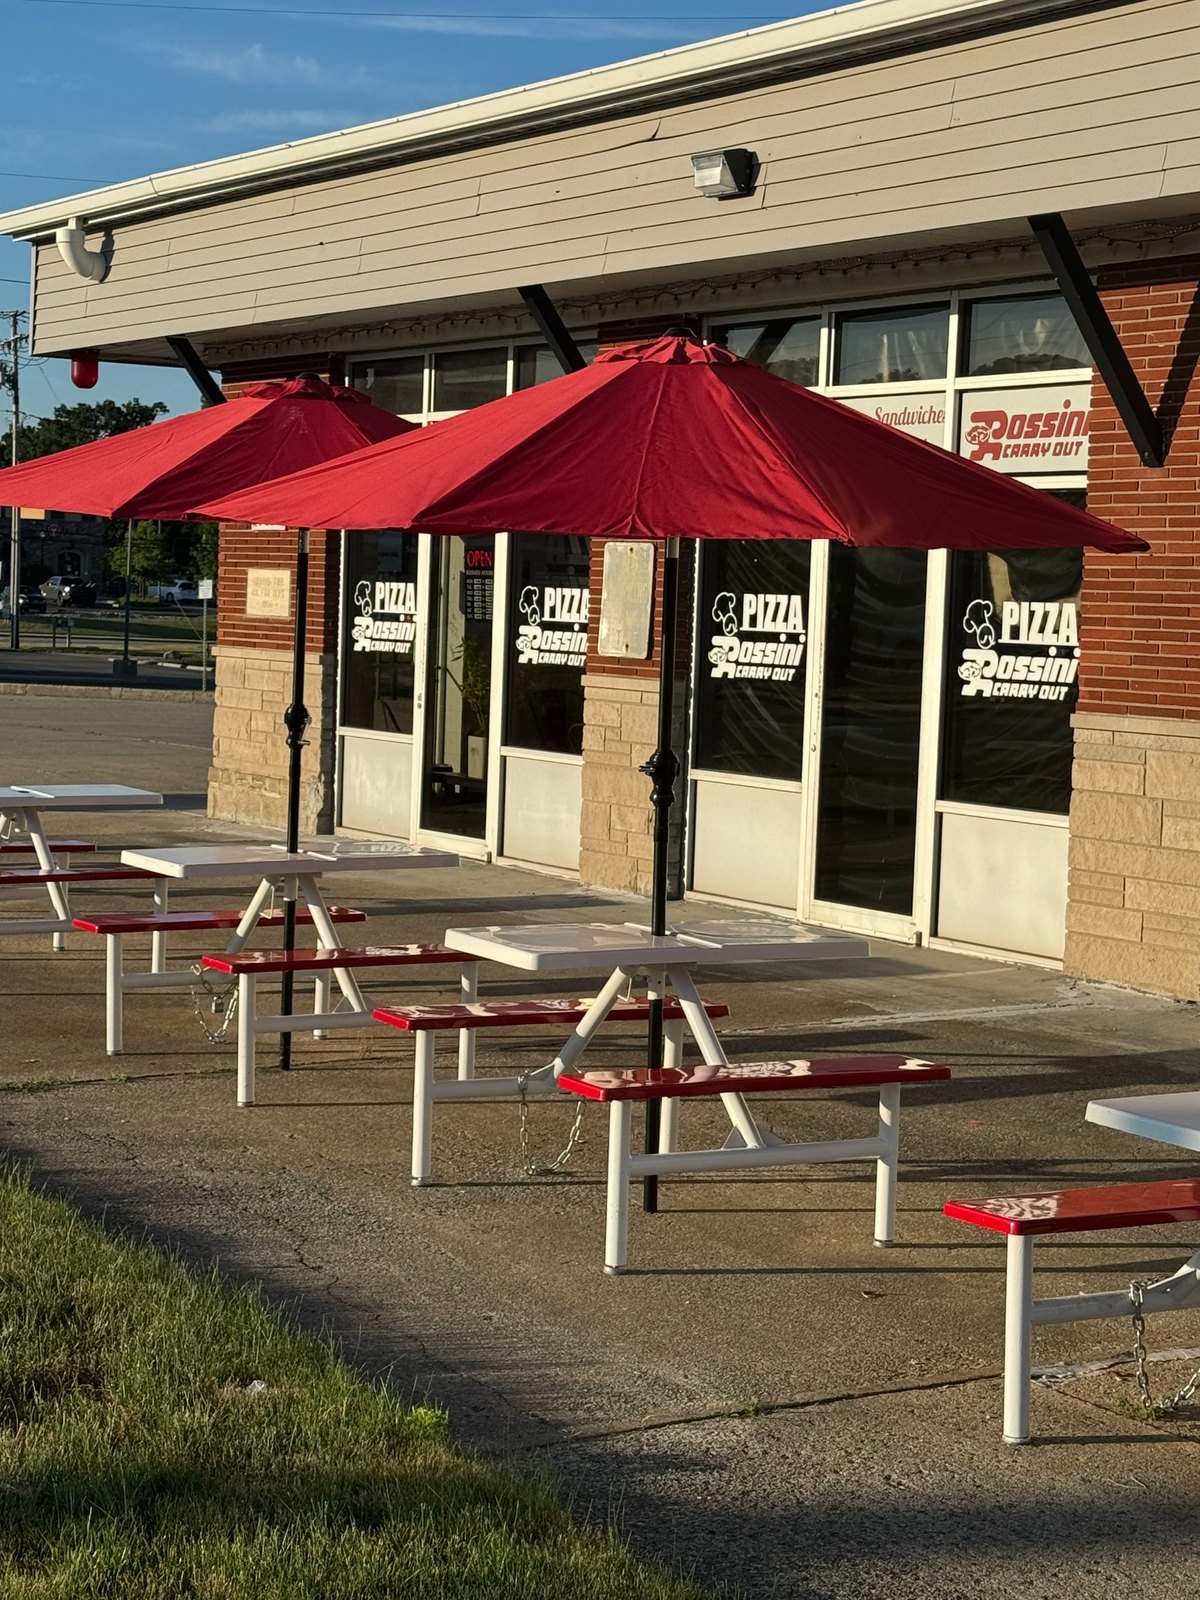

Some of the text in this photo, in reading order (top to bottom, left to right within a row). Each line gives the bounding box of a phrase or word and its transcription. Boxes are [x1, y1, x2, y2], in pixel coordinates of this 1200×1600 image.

[1002, 441, 1083, 458] CARRY OUT
[467, 550, 492, 567] OPEN
[374, 582, 417, 613] PIZZA
[543, 587, 589, 622] PIZZA
[741, 593, 805, 633] PIZZA
[999, 601, 1079, 646] PIZZA
[371, 641, 411, 654] CARRY OUT
[516, 623, 588, 664] Rossin
[538, 652, 587, 667] CARRY OUT
[735, 665, 796, 681] CARRY OUT
[992, 682, 1069, 701] CARRY OUT
